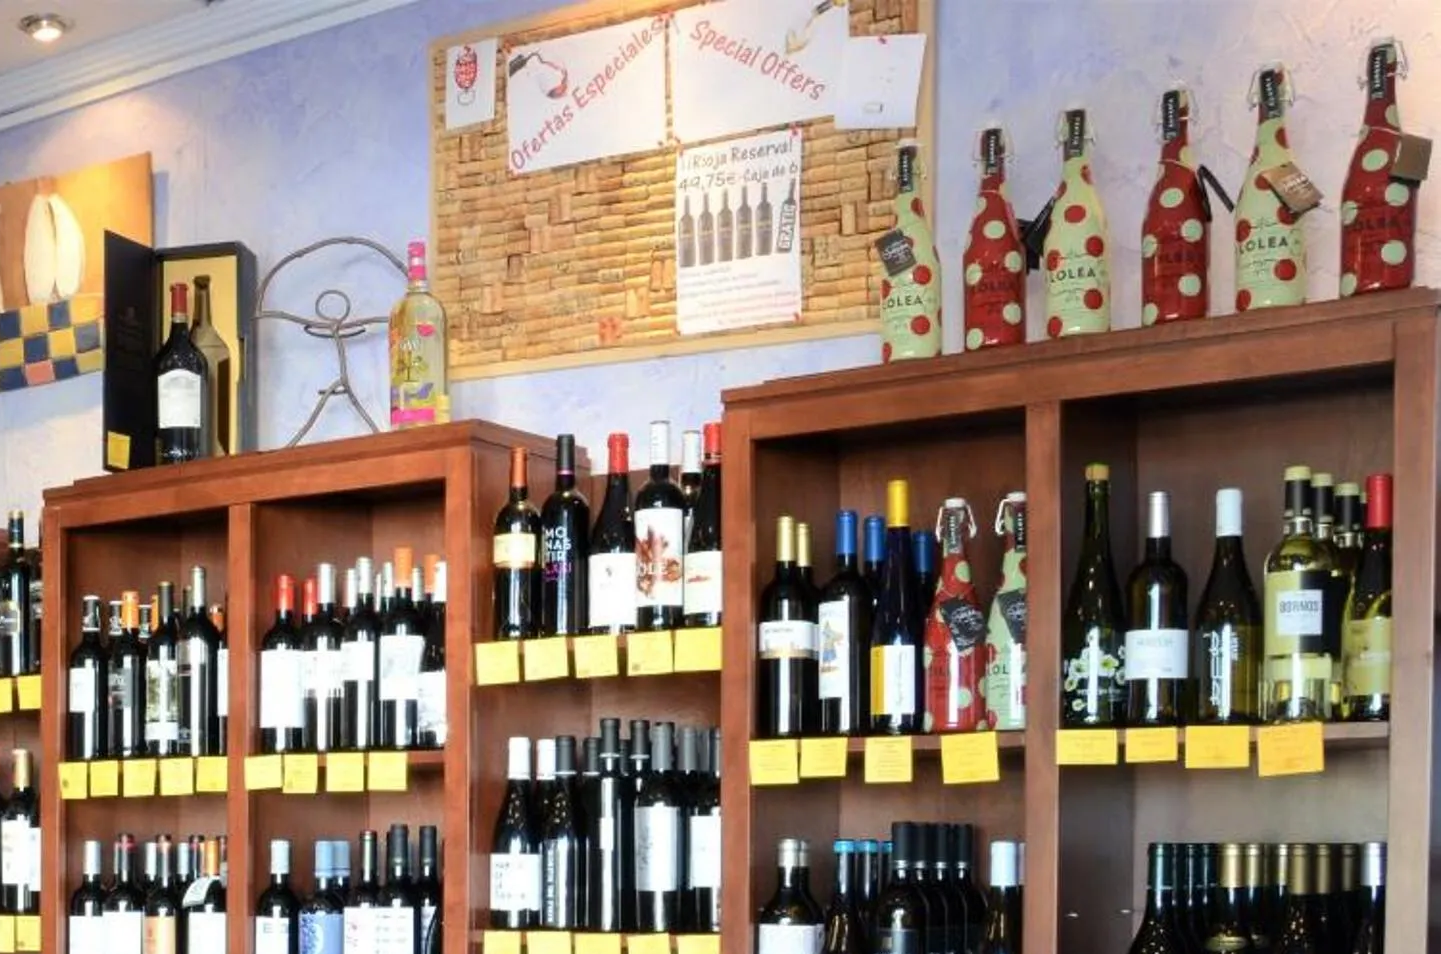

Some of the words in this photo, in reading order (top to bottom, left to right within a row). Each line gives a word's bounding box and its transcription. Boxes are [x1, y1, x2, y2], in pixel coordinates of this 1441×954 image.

[511, 105, 574, 170] Ofertas
[572, 14, 665, 109] Especiales
[690, 20, 756, 68] Special
[761, 51, 826, 101] Offers
